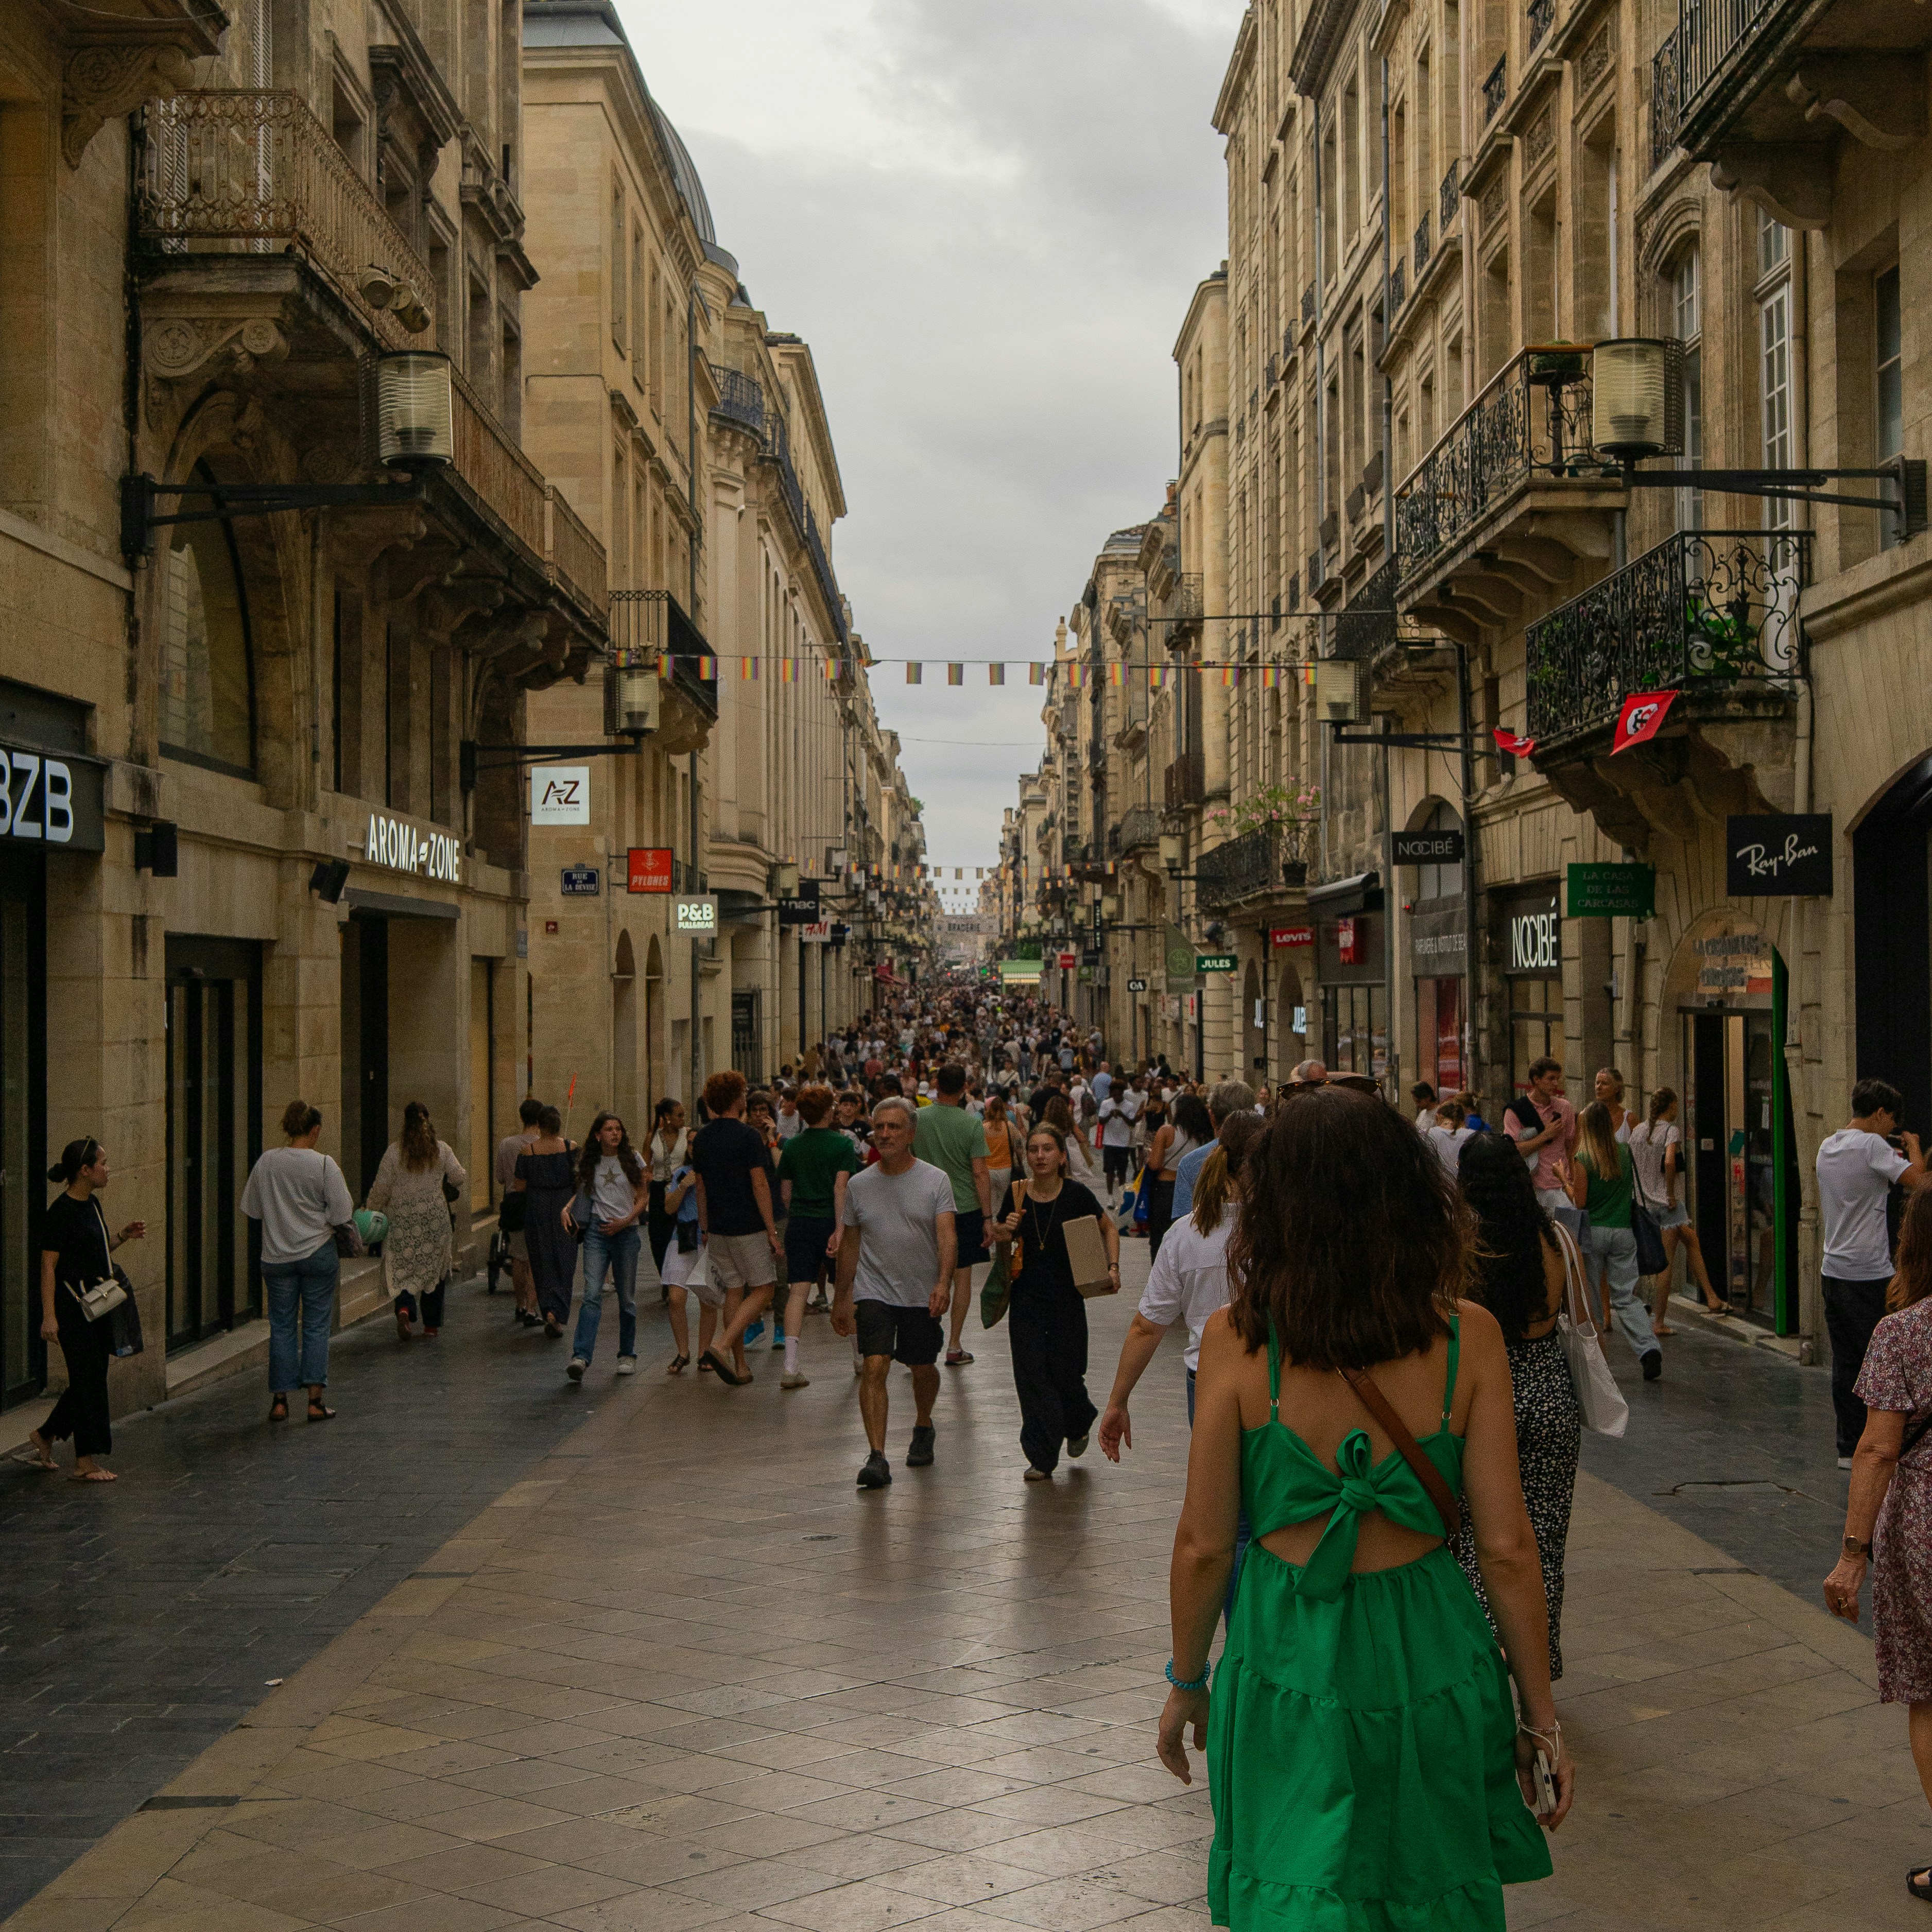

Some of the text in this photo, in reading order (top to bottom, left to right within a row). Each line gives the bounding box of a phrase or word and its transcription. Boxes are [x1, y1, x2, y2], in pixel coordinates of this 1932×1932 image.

[368, 814, 460, 882] AROMA ZONE
[1398, 836, 1454, 855] NOCIBÉ
[1583, 871, 1634, 881] LA CASA
[1586, 885, 1630, 894] DE LAS
[1577, 899, 1639, 909] CARCASAS
[678, 903, 715, 921] P&B
[1512, 896, 1558, 969] NOCIBÉ
[1201, 959, 1231, 969] JULES
